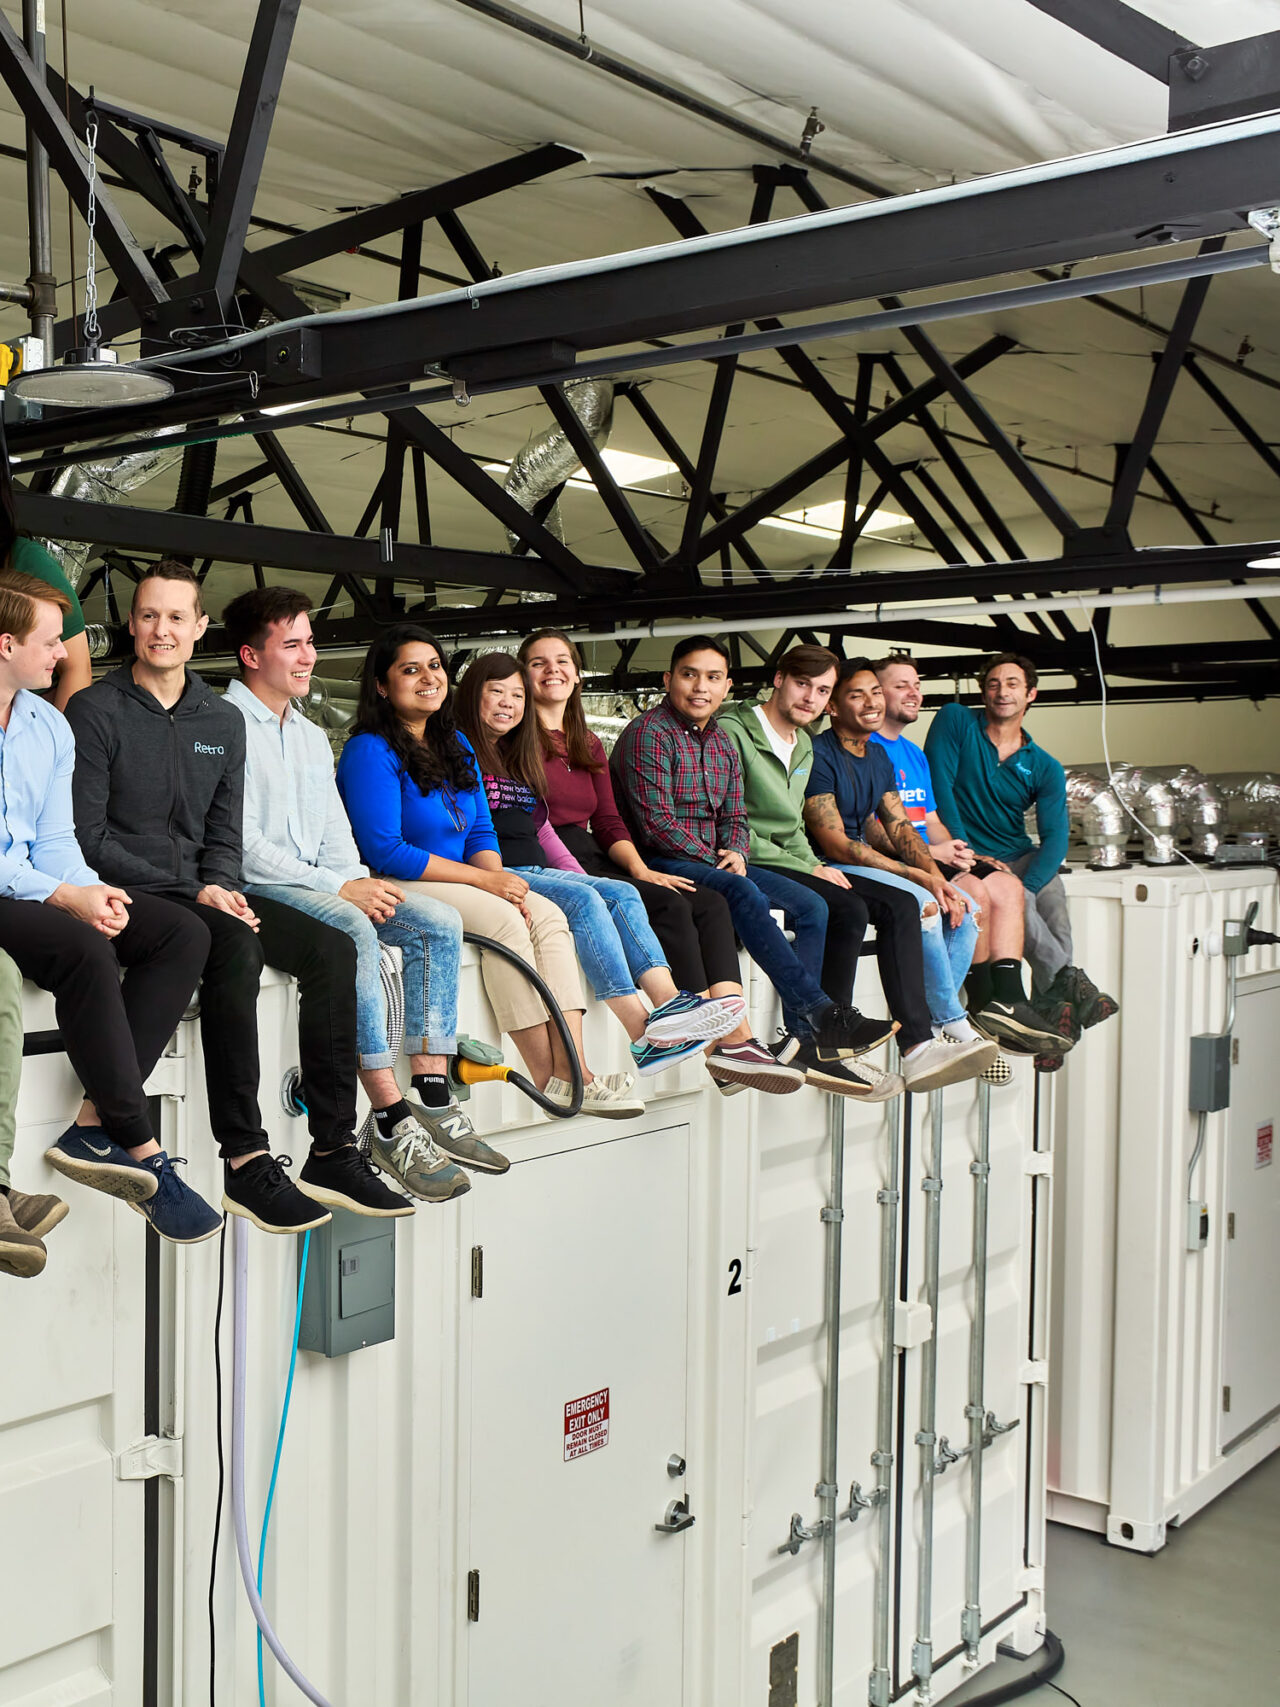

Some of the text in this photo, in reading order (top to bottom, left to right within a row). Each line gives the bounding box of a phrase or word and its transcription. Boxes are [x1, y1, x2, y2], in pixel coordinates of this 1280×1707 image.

[194, 741, 225, 755] Retro
[424, 1076, 445, 1085] PUMA
[727, 1258, 742, 1296] 2
[566, 1390, 608, 1417] EMERGENCY
[569, 1407, 605, 1432] EXIT ONLY
[566, 1429, 607, 1451] REMAIN CLOSED
[572, 1423, 602, 1441] DOOR MUST
[569, 1438, 604, 1458] AT ALL TIMES
